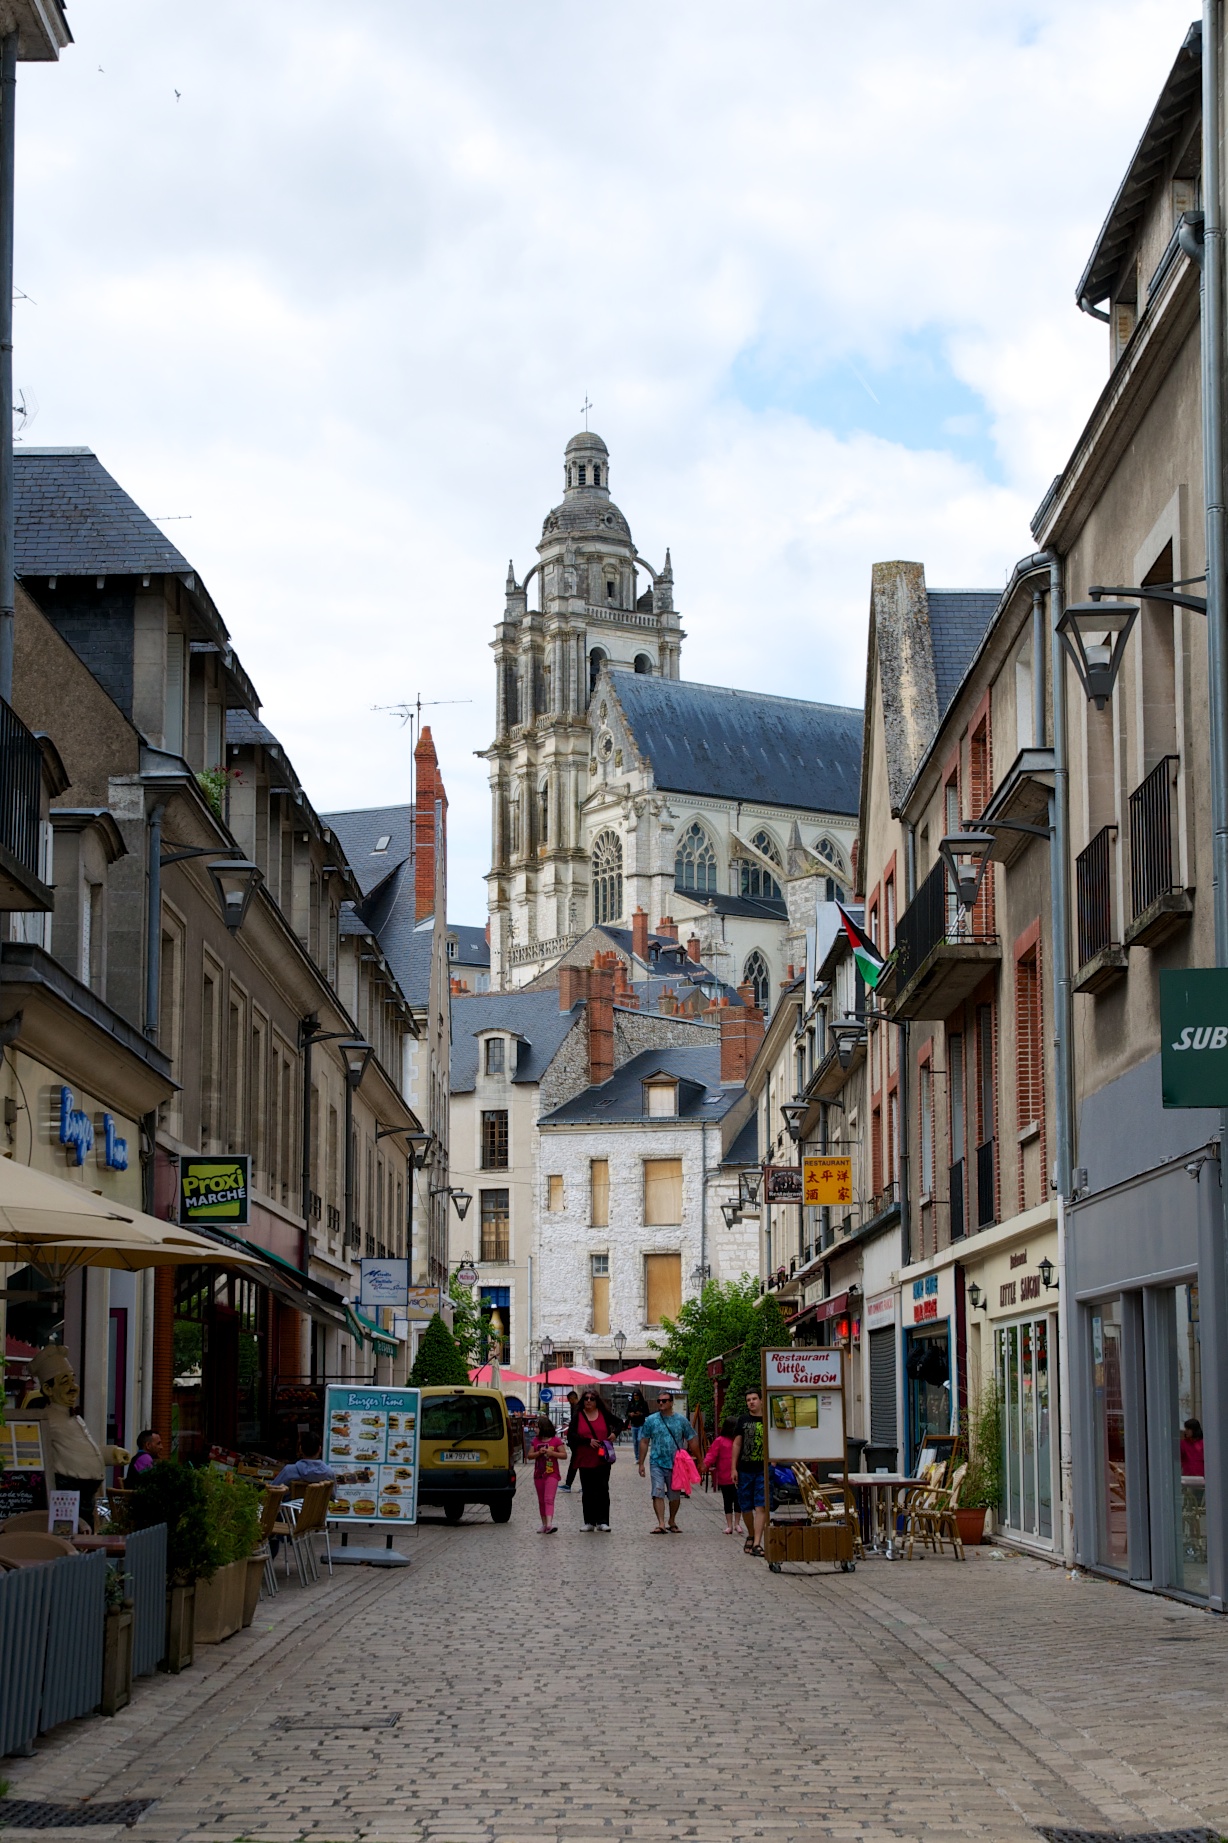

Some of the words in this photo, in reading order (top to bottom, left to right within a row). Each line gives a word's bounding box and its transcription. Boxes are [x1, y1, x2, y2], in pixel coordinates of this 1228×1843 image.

[1171, 1026, 1228, 1051] SUB
[182, 1168, 245, 1197] Proxi
[806, 1169, 849, 1183] 太平洋
[184, 1185, 247, 1208] MARCHÉ
[806, 1186, 850, 1201] 酒家
[1000, 1281, 1016, 1308] LITTLE
[771, 1353, 830, 1362] Restaurant
[347, 1393, 379, 1410] Burger
[381, 1393, 404, 1406] Time
